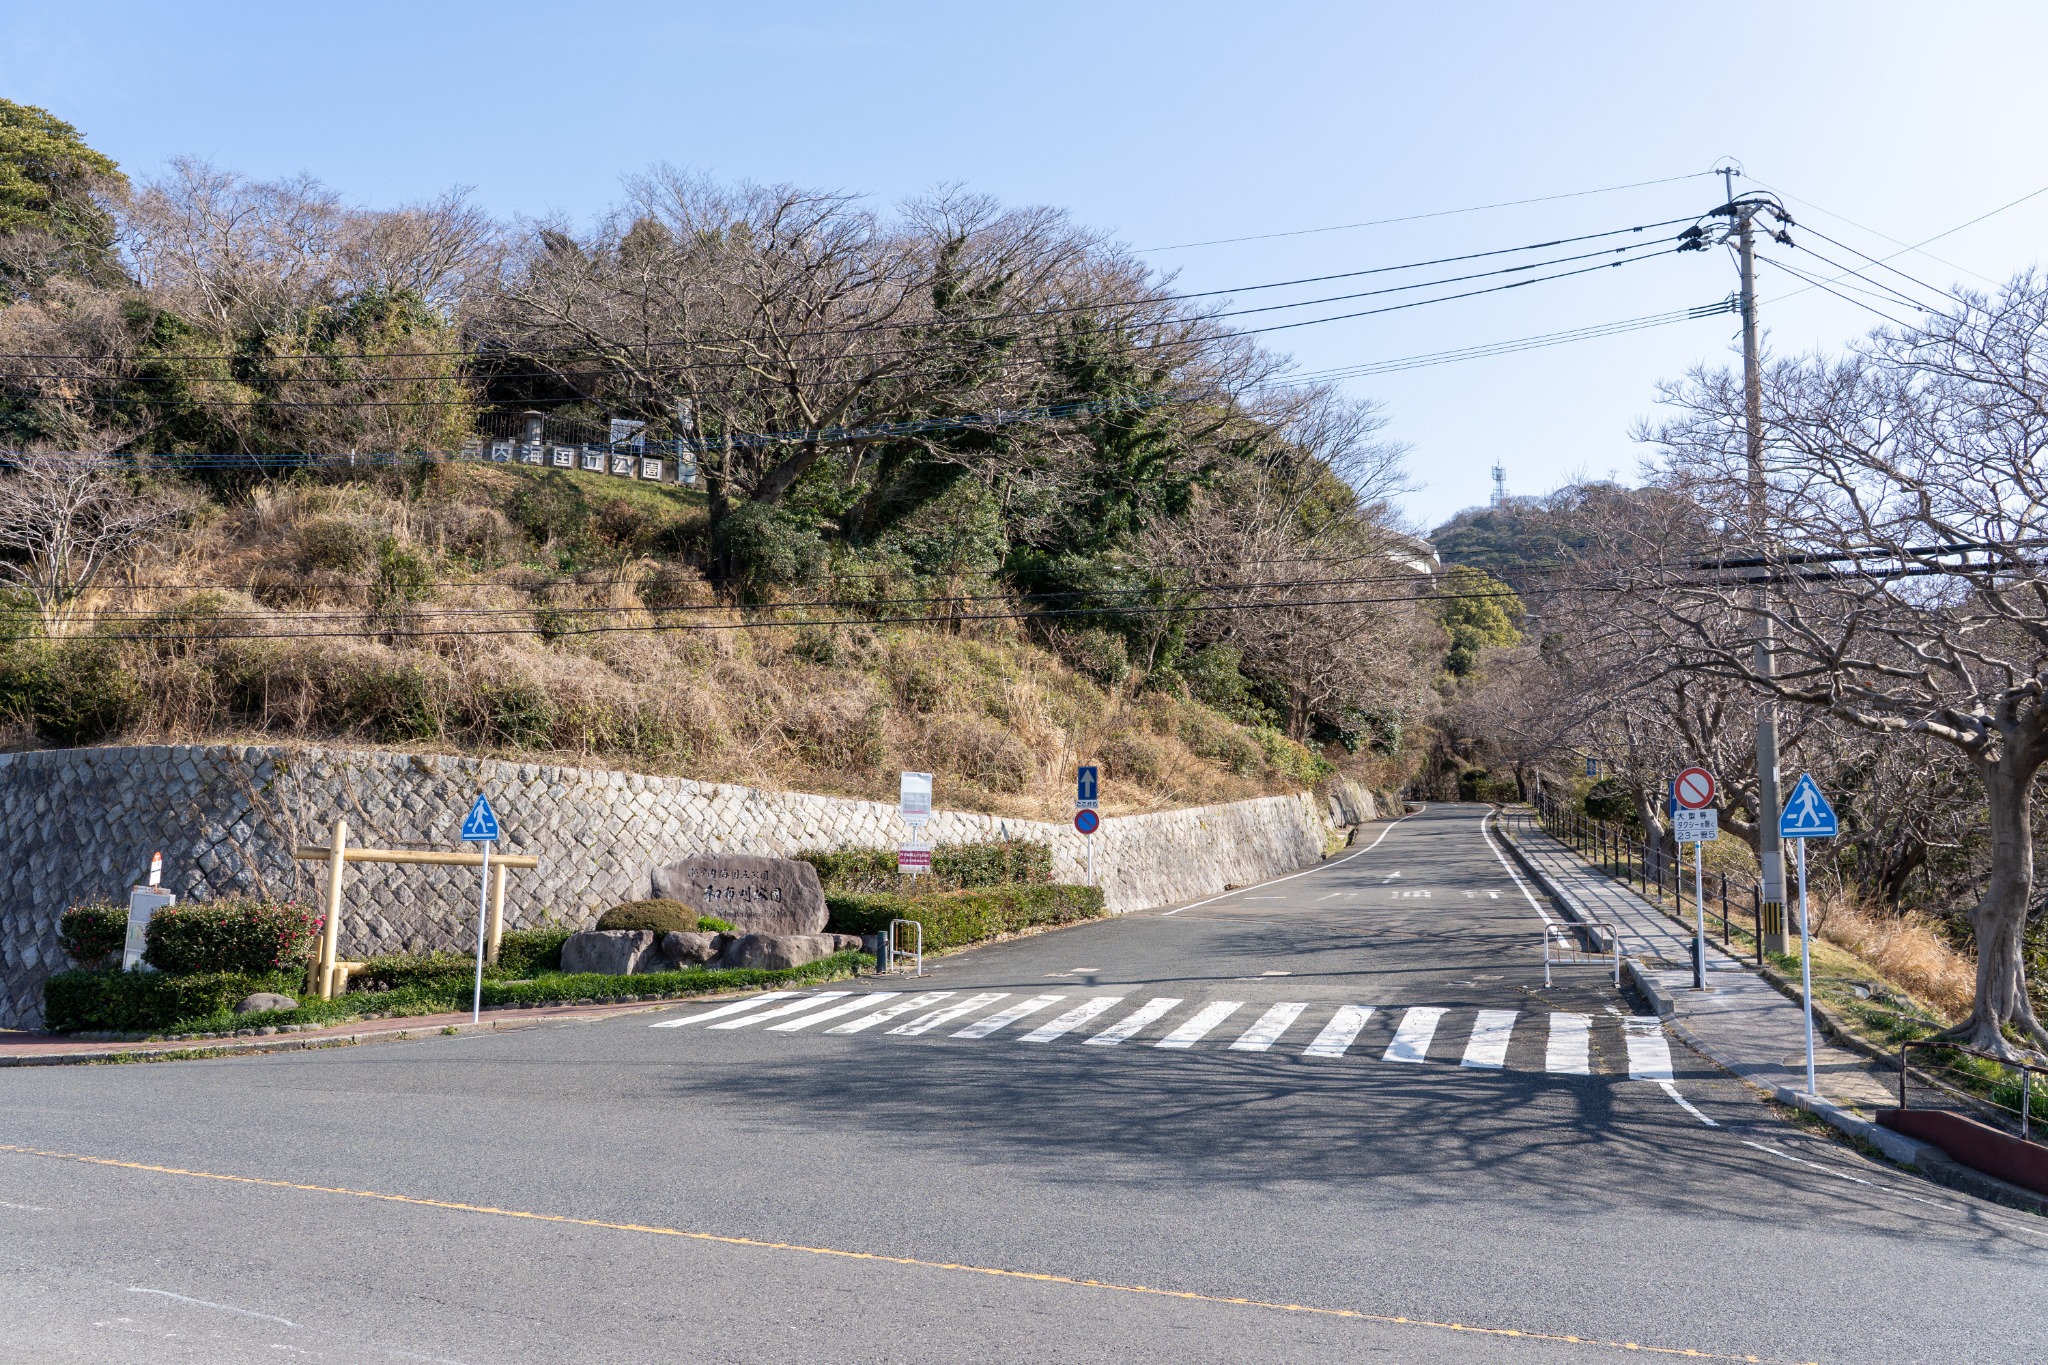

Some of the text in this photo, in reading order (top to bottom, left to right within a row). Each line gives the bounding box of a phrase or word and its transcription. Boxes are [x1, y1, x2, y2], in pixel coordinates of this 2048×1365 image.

[704, 884, 782, 903] 和布刈公園
